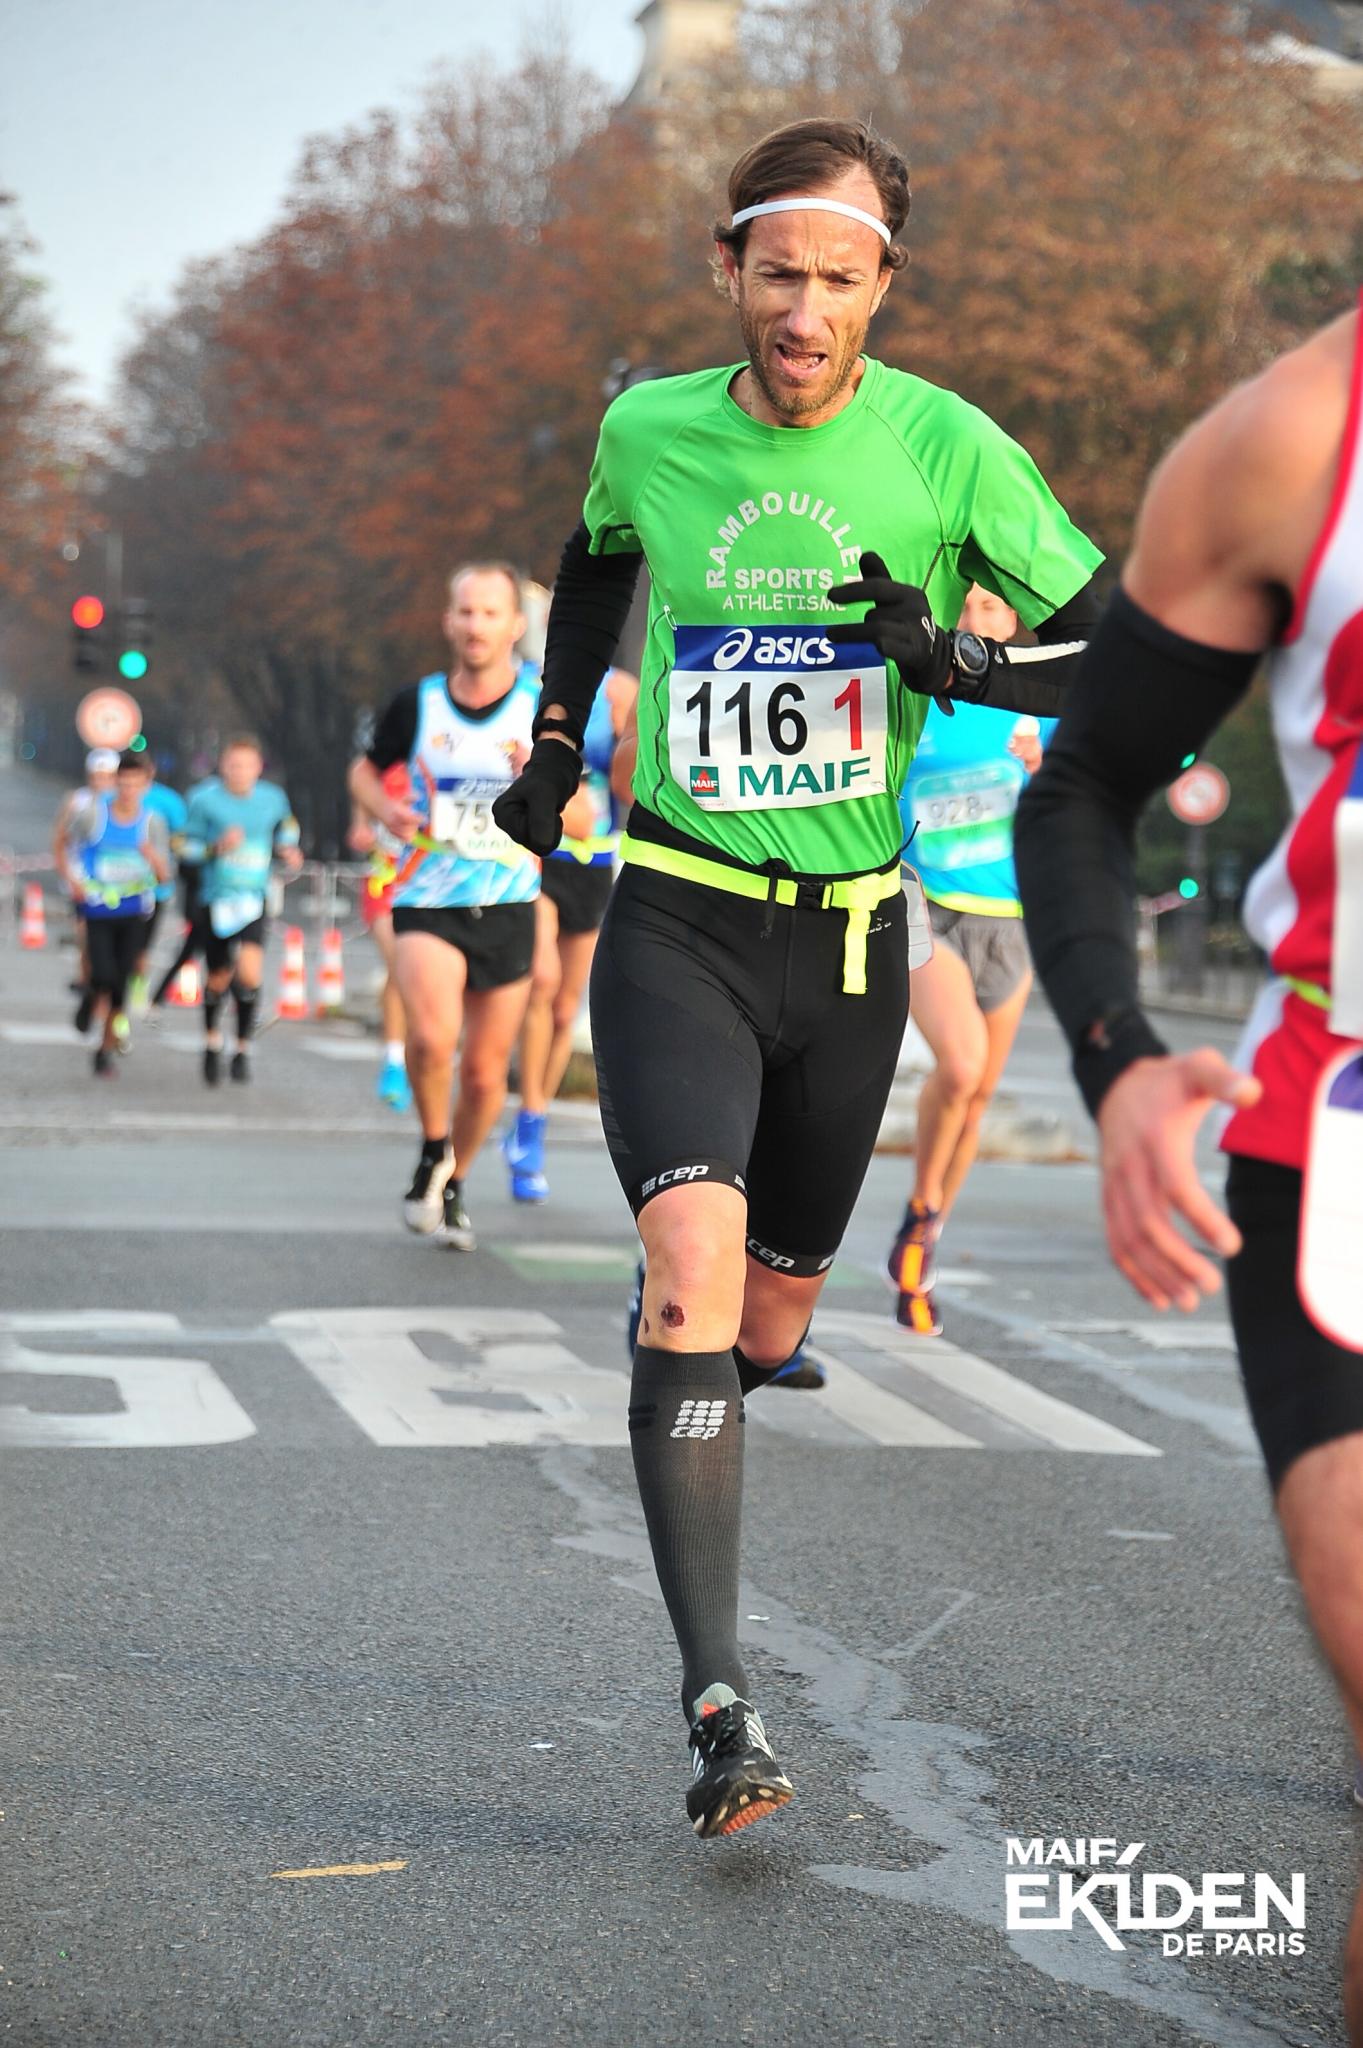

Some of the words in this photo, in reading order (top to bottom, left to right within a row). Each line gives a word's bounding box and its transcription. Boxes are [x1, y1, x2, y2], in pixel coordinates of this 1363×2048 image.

[734, 568, 834, 590] SPORTS
[686, 681, 808, 757] 116
[834, 678, 862, 751] 1
[691, 779, 719, 788] MAIF
[738, 757, 871, 797] MAIF
[658, 1164, 710, 1186] cep
[747, 1238, 795, 1268] cep
[670, 1425, 721, 1440] cep
